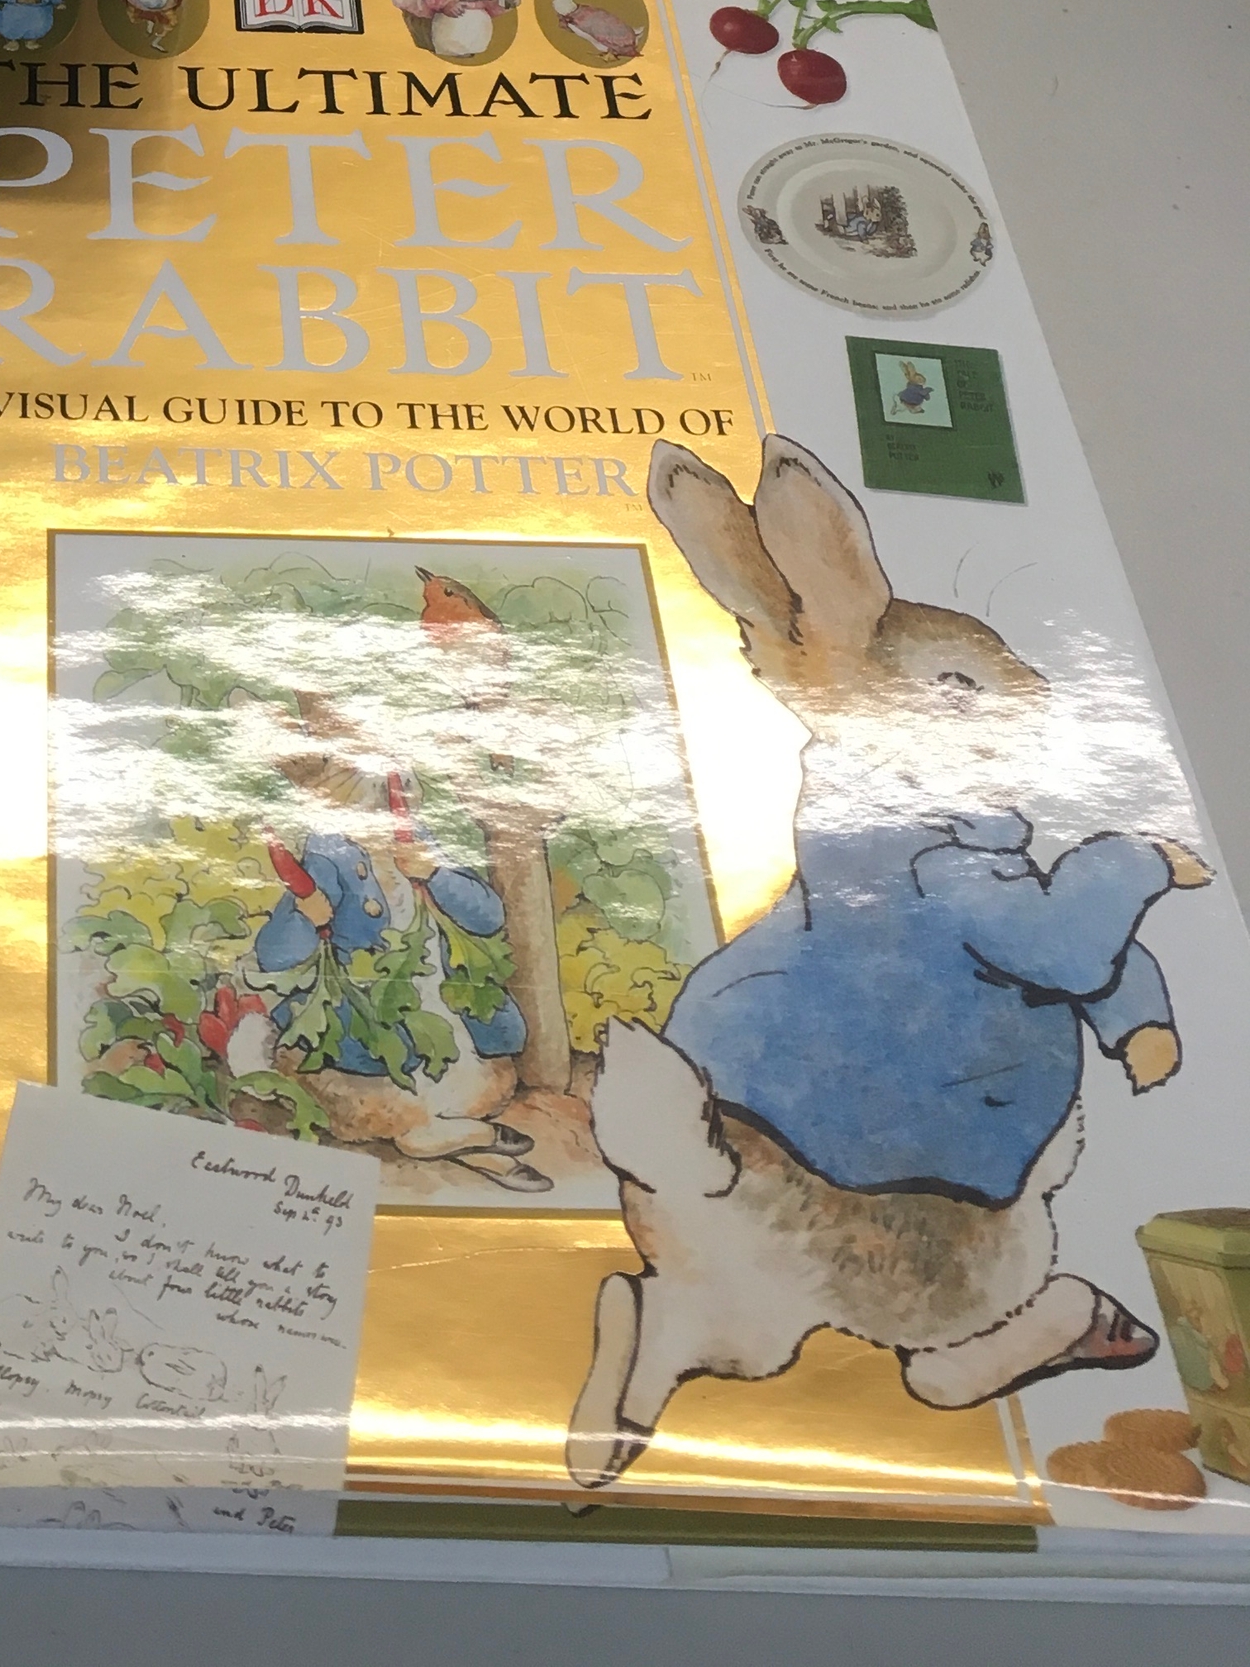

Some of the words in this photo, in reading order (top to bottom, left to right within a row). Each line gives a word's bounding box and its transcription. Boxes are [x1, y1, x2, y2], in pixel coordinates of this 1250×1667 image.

[178, 65, 652, 120] ULTIMATE
[162, 396, 308, 428] GUIDE
[321, 400, 384, 430] TO
[396, 402, 491, 433] THE
[500, 404, 666, 436] WORLD
[678, 408, 735, 438] OF
[48, 443, 343, 490] BEATRIX
[362, 451, 641, 498] POTTER
[23, 1177, 62, 1217] My
